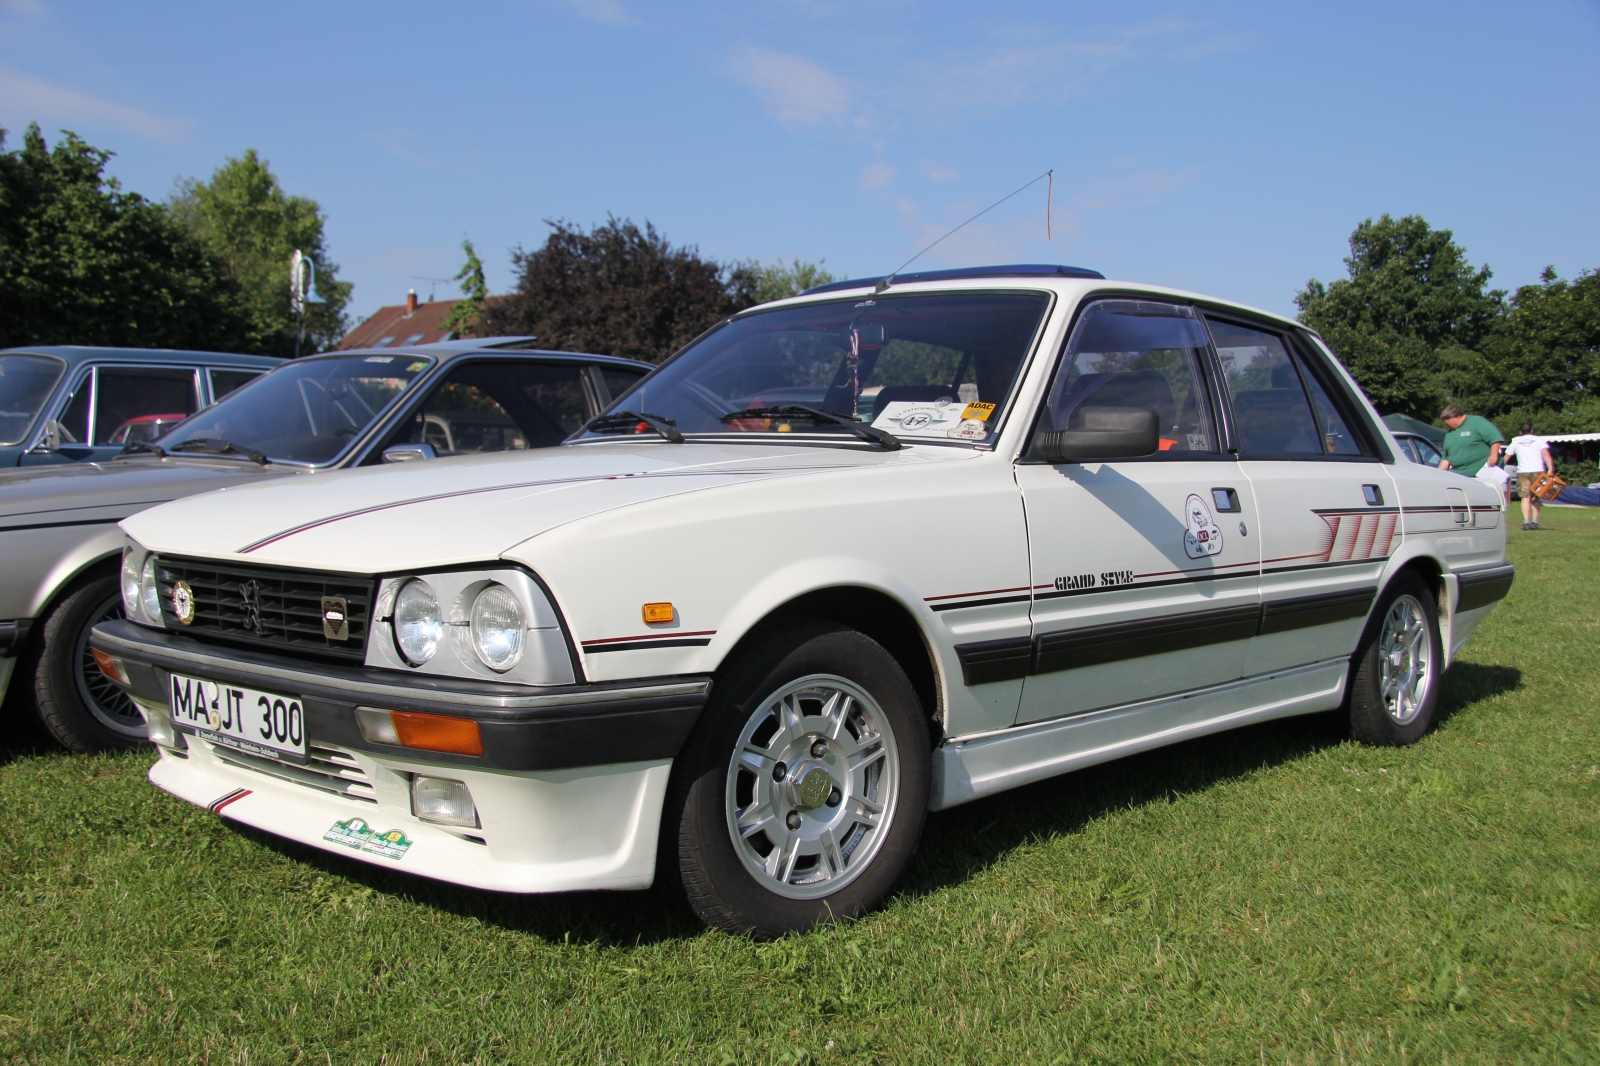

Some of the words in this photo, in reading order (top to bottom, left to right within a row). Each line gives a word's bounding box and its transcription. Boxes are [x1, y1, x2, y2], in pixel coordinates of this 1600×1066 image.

[967, 402, 994, 411] ADAC
[903, 416, 929, 427] 17
[1054, 573, 1096, 591] GRAND
[1100, 570, 1134, 587] STYLE
[257, 695, 303, 747] 300
